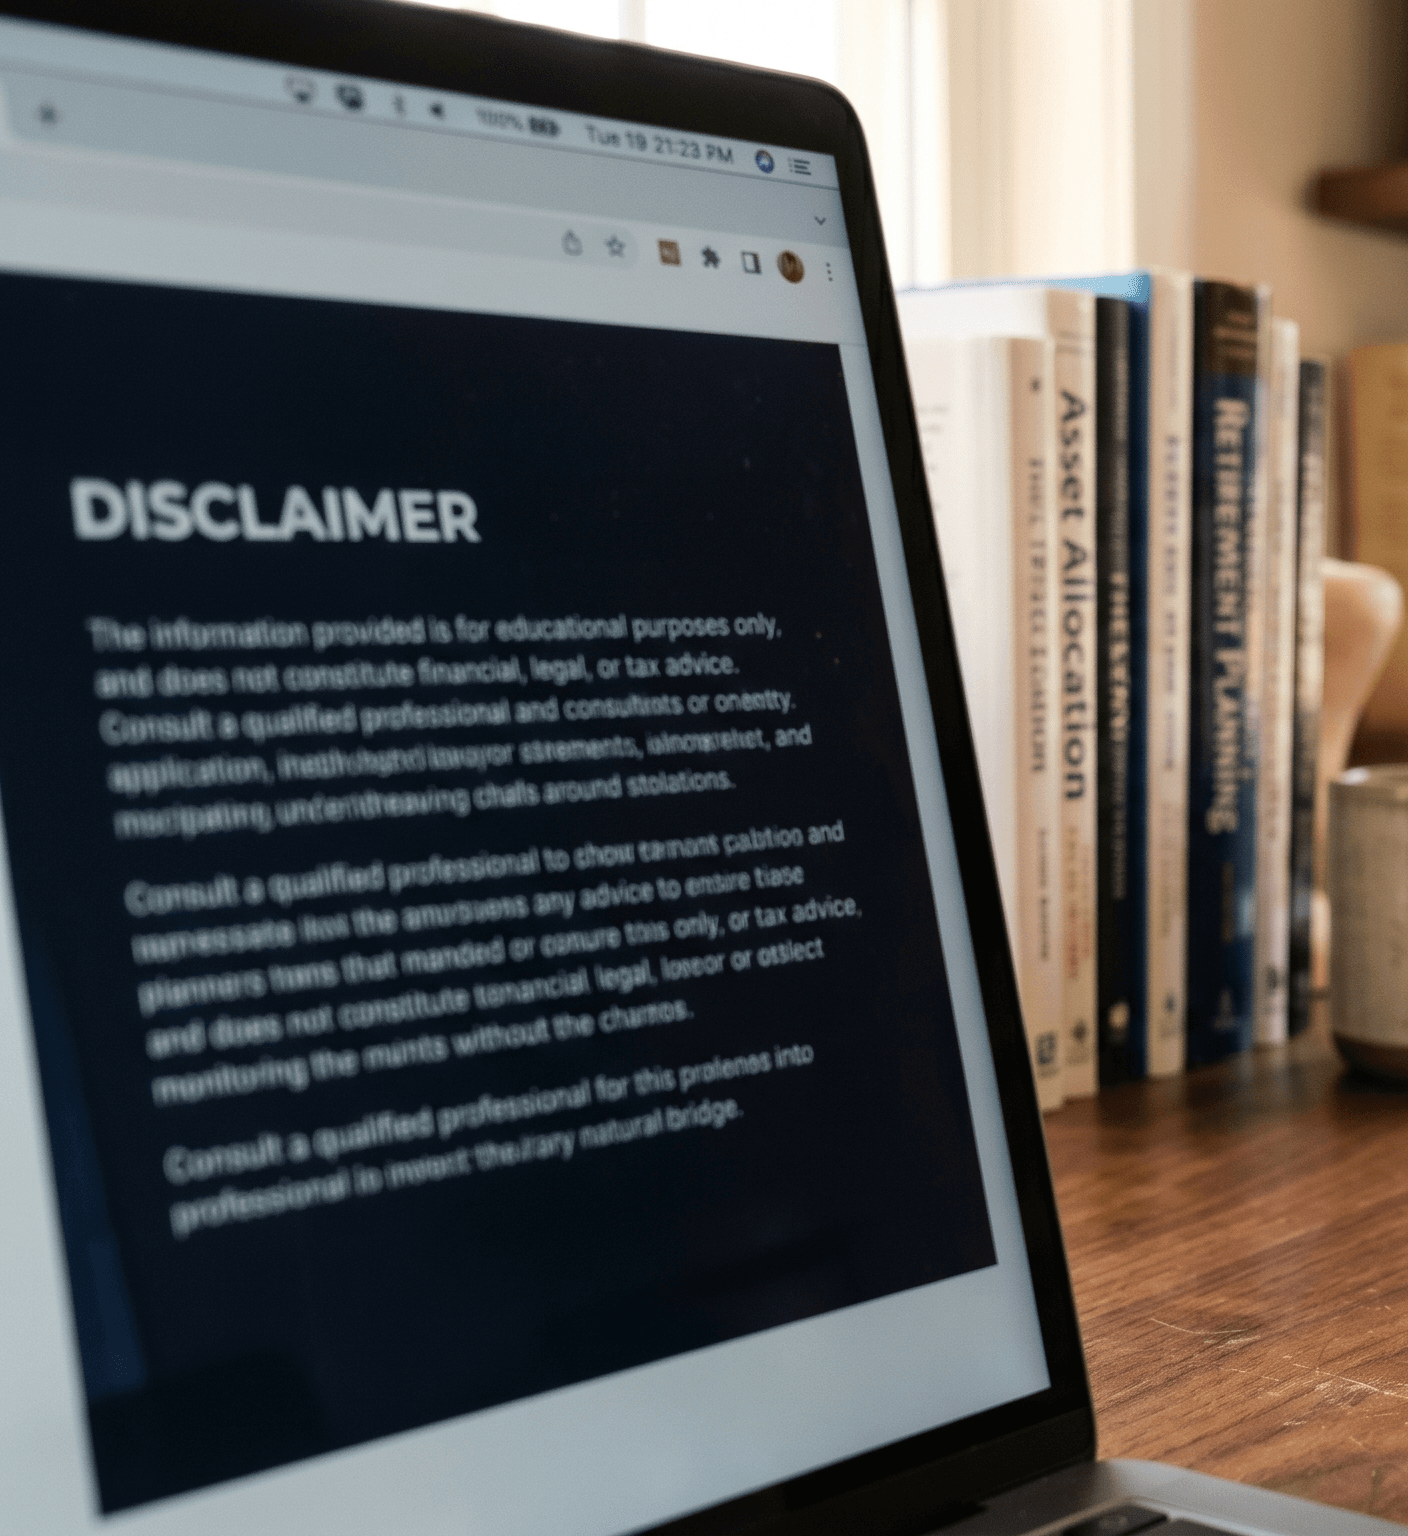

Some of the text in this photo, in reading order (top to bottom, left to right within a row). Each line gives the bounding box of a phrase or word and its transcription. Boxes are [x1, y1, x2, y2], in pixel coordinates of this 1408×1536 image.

[585, 123, 734, 165] Tue 19 21:23 PM
[1060, 390, 1087, 520] Asset
[70, 476, 482, 543] DISCLAIMER
[149, 617, 309, 650] information
[311, 617, 426, 651] provided
[428, 617, 453, 644] is
[454, 614, 491, 643] for
[494, 614, 628, 642] educational
[631, 617, 730, 643] purposes
[95, 652, 739, 699] and does not constitute financial, legal, or tax advice.
[1062, 538, 1088, 801] Allocation
[99, 709, 214, 746] Consult
[216, 712, 243, 740] a
[240, 703, 358, 742] qualified
[359, 699, 511, 736] professional
[514, 697, 560, 724] and
[687, 694, 710, 714] or
[775, 723, 813, 747] and
[541, 773, 623, 805] around
[124, 875, 246, 917] Consult
[243, 877, 268, 905] a
[267, 862, 389, 904] qualified
[387, 848, 540, 893] professional
[542, 848, 570, 872] to
[808, 820, 845, 845] and
[533, 892, 575, 919] any
[580, 880, 654, 910] advice
[656, 877, 682, 900] to
[508, 937, 536, 962] or
[728, 910, 750, 932] or
[753, 906, 787, 928] tax
[147, 1020, 210, 1059] and
[208, 1015, 288, 1049] does
[285, 1005, 334, 1036] not
[337, 988, 470, 1030] constitute
[730, 949, 753, 971] or
[152, 1057, 312, 1104] monitoring
[308, 1050, 359, 1080] the
[451, 1017, 551, 1056] without
[163, 1133, 290, 1184] Consult
[287, 1133, 316, 1162] a
[312, 1108, 435, 1160] qualified
[436, 1079, 591, 1139] professional
[593, 1075, 630, 1101] for
[628, 1066, 676, 1095] this
[774, 1044, 814, 1069] into
[170, 1170, 352, 1236] professional
